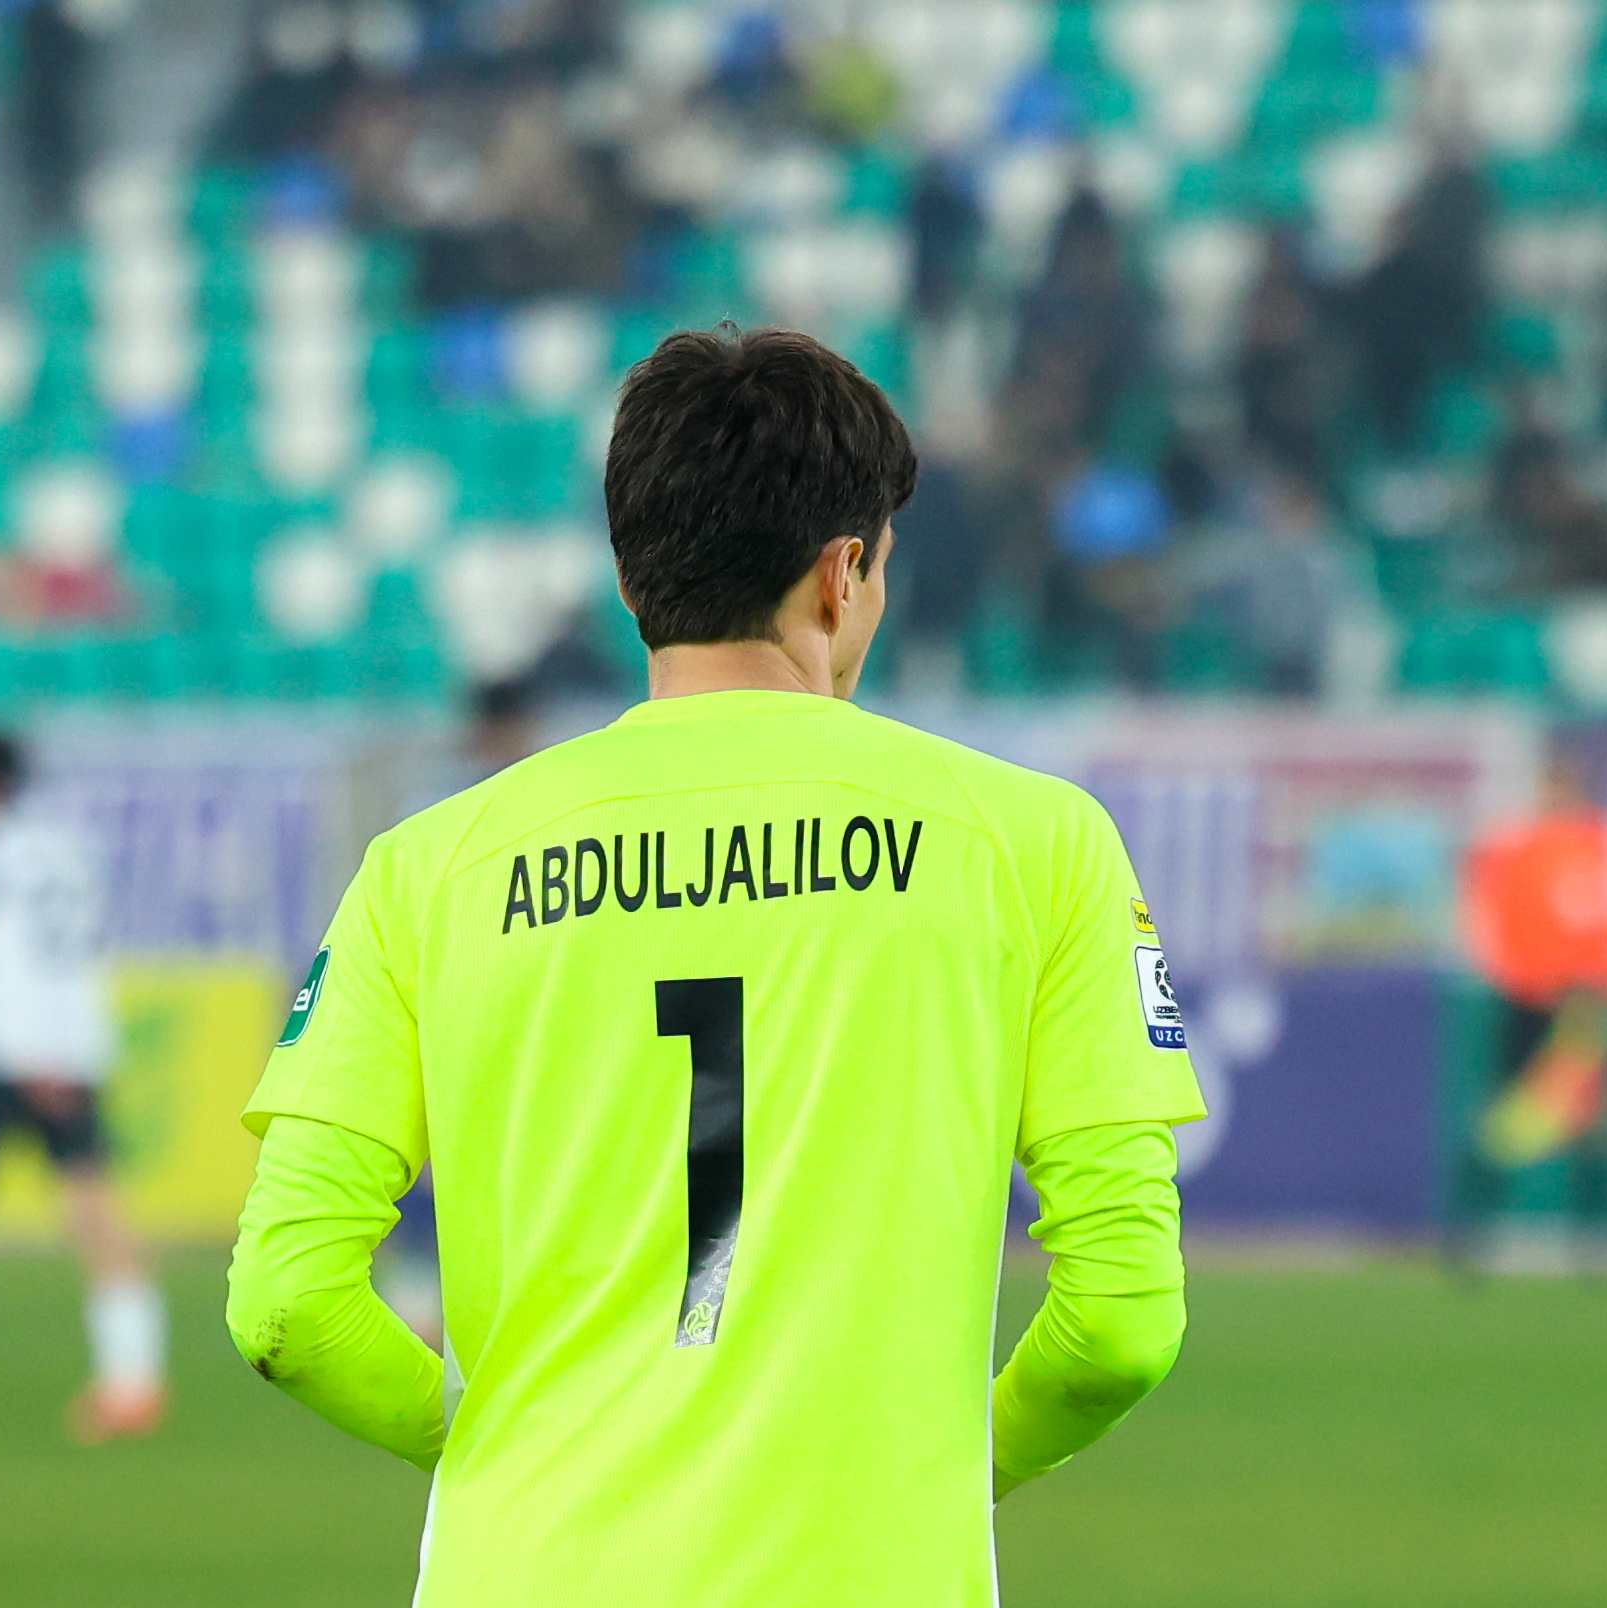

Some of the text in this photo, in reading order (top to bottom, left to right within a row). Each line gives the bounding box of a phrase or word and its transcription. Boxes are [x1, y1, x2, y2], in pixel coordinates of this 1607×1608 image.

[502, 815, 923, 934] ABDULJALILOV
[1155, 1029, 1184, 1042] UZC
[655, 976, 744, 1348] 1
